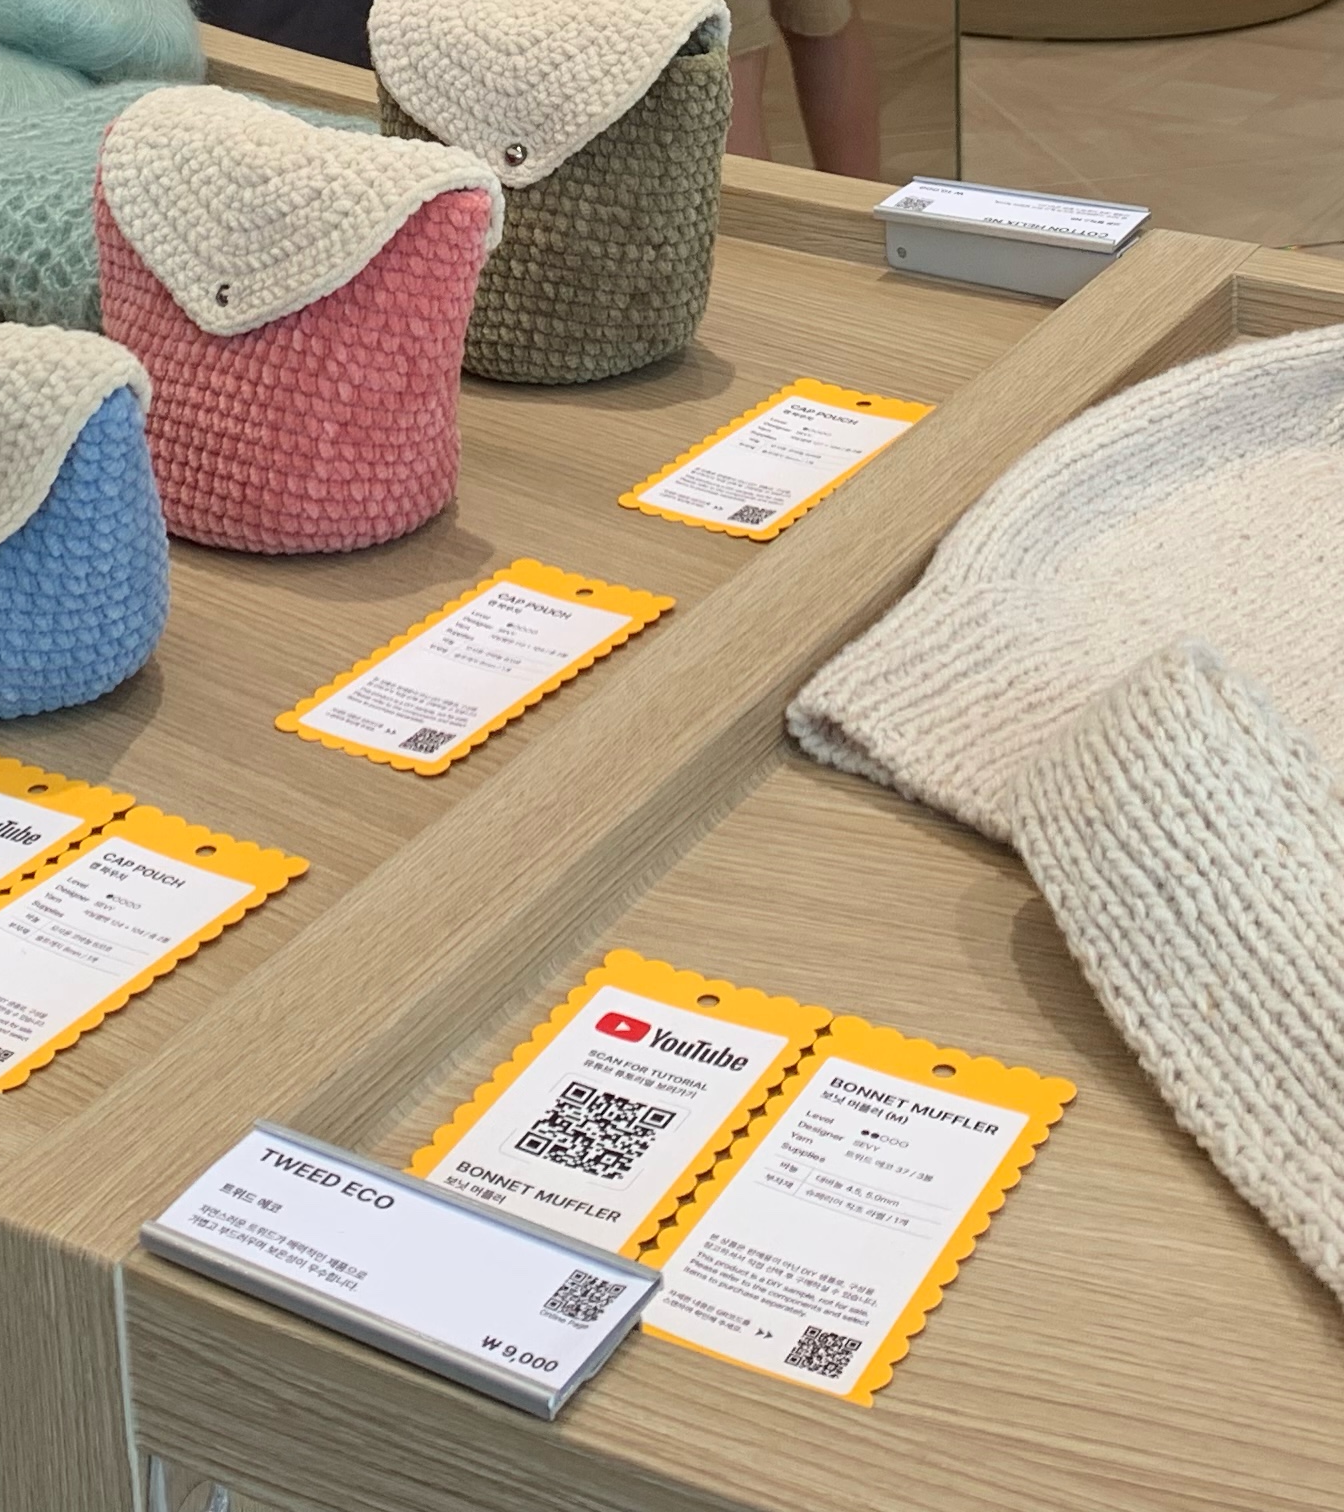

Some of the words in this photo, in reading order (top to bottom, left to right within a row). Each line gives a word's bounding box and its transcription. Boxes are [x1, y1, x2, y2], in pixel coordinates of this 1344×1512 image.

[791, 404, 816, 413] CAP
[816, 411, 859, 425] POUCH
[498, 593, 525, 605] CAP
[525, 601, 572, 620] POUCH
[66, 877, 89, 889] Level
[103, 853, 135, 867] CAP
[132, 864, 185, 888] POUCH
[31, 900, 64, 918] Supplies
[44, 892, 62, 903] Yarn
[55, 884, 89, 902] Designer
[584, 1059, 614, 1075] 유튜브
[648, 1028, 750, 1073] YouTube
[587, 1049, 622, 1067] SCAN
[622, 1059, 650, 1075] FOR
[650, 1066, 708, 1092] TUTORIAL
[806, 1110, 835, 1125] Level
[820, 1090, 846, 1106] 보닛
[847, 1098, 884, 1118] 머플러
[885, 1111, 910, 1126] (M)
[830, 1077, 910, 1110] BONNET
[911, 1102, 1000, 1136] MUFFLER
[781, 1141, 826, 1164] Supplies
[790, 1131, 814, 1145] Yarn
[895, 1165, 910, 1175] 37
[797, 1120, 845, 1143] Designer
[852, 1139, 880, 1153] SEVY
[260, 1148, 342, 1188] TWEED
[341, 1181, 395, 1210] ECO
[443, 1175, 472, 1193] 보닛
[471, 1183, 508, 1205] 머플러
[455, 1161, 538, 1198] BONNET
[534, 1188, 622, 1224] MUFFLER
[219, 1182, 257, 1204] 트위드
[256, 1198, 283, 1214] 에코
[188, 1213, 219, 1232] 가볍고
[217, 1226, 267, 1251] 부드러우며
[265, 1245, 307, 1269] 보온성이
[307, 1263, 358, 1292] 우수합니다.
[199, 1203, 247, 1229] 자연스러운
[248, 1223, 287, 1245] 트위드가
[286, 1239, 328, 1263] 매력적인
[327, 1258, 368, 1281] 제품으로
[683, 1266, 708, 1280] items
[718, 1280, 765, 1302] purchase
[760, 1296, 807, 1317] separately.
[690, 1258, 718, 1274] Please
[720, 1270, 740, 1282] refer
[753, 1282, 767, 1293] the
[767, 1289, 822, 1314] components
[823, 1308, 842, 1318] and
[842, 1314, 869, 1327] select
[697, 1251, 715, 1264] This
[715, 1258, 750, 1278] product
[765, 1278, 783, 1289] DIY
[819, 1297, 835, 1307] not
[835, 1302, 848, 1311] for
[540, 1309, 566, 1324] Online
[567, 1319, 589, 1330] Page
[481, 1335, 502, 1351] ₩
[503, 1345, 559, 1372] 9,000
